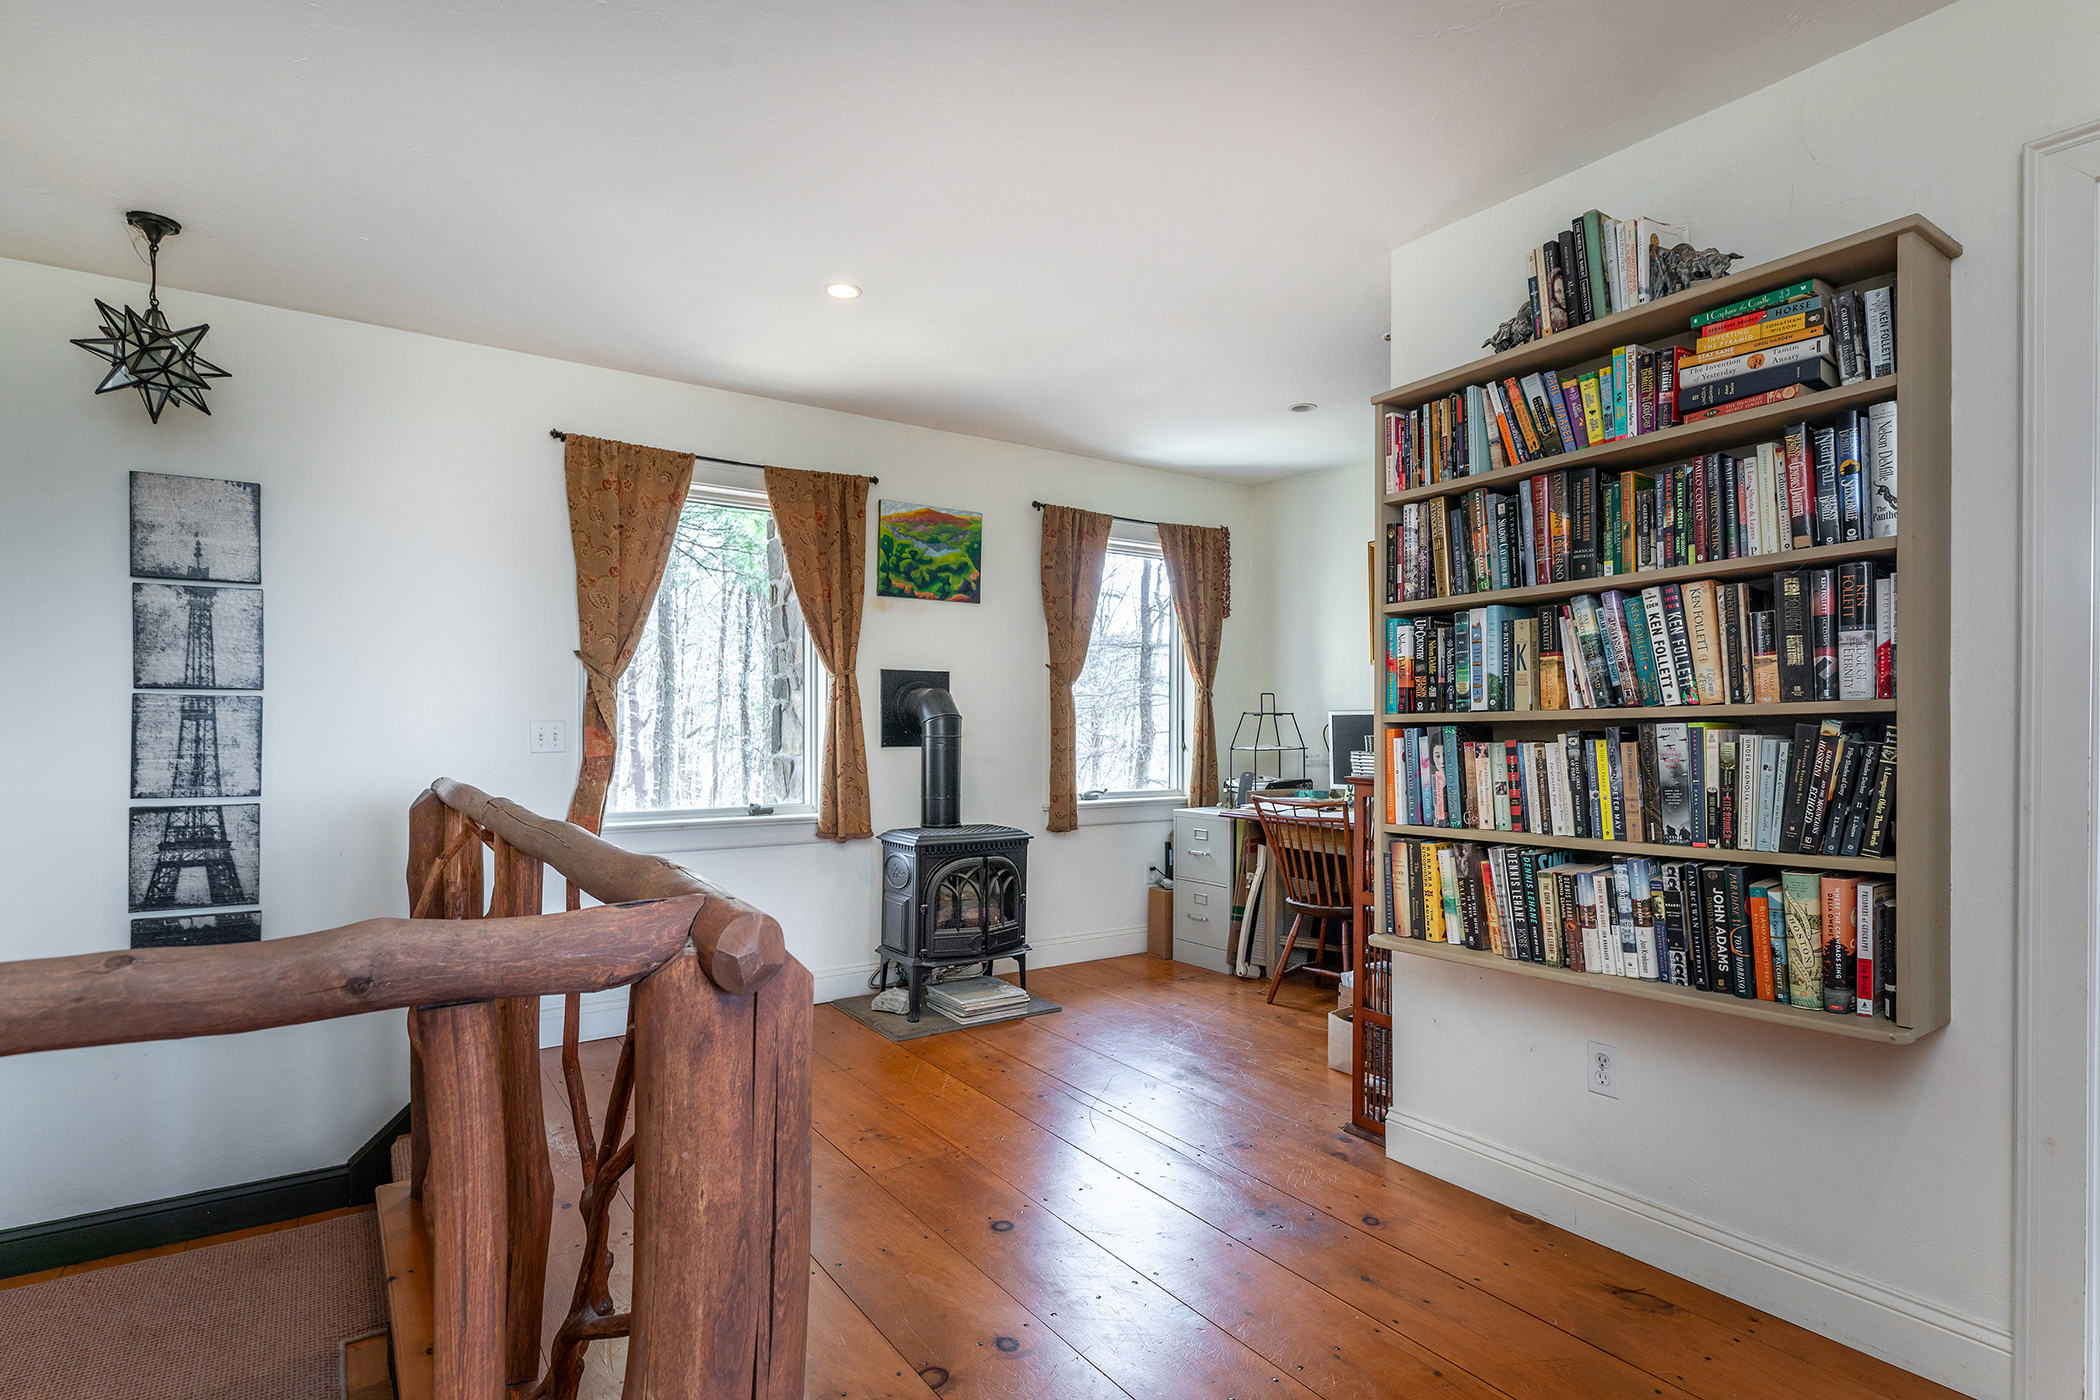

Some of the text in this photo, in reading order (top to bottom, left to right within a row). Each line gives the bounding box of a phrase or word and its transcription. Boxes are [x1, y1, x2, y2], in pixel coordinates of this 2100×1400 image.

[1567, 281, 1575, 297] Aleph
[1711, 306, 1738, 319] Capture
[1739, 303, 1747, 311] the
[1748, 295, 1770, 308] Castle
[1775, 300, 1811, 317] HORSE
[1880, 311, 1889, 327] KEN
[1707, 329, 1749, 343] INVERTING
[1708, 316, 1758, 333] GERALDINE BROOKS
[1766, 317, 1802, 330] JONATHAN
[1770, 323, 1797, 333] WILSON
[1697, 347, 1735, 360] STAY SANE
[1719, 334, 1753, 347] PYRAMID
[1754, 334, 1793, 348] GREG HARDEN
[1772, 344, 1800, 355] Tamim
[1880, 330, 1891, 363] FOLLETT
[1626, 360, 1636, 384] Sheltering
[1702, 368, 1737, 381] Yesterday
[1706, 358, 1741, 371] Invention
[1772, 353, 1800, 364] Ansary
[1547, 373, 1574, 444] CARL HIAASEN
[1726, 400, 1763, 414] SECRET SENSES
[1878, 420, 1893, 481] Nelson DeMille
[1553, 474, 1562, 528] DAN BROWN
[1695, 488, 1703, 521] COELHO
[1778, 472, 1788, 511] Educated
[1430, 502, 1438, 538] ATWOOD
[1582, 477, 1590, 542] WILDERNESS WARRIOR
[1710, 491, 1719, 551] PAULO COELHO
[1873, 513, 1897, 521] Panthe
[1552, 535, 1564, 580] INFERNO
[1784, 578, 1802, 630] KEN FOLLETT
[1842, 574, 1855, 618] FOLLETT
[1856, 584, 1868, 606] KEN
[1575, 608, 1587, 634] CONROY
[1689, 588, 1709, 652] KEN FOLLETT
[1726, 601, 1735, 625] FOLLETT
[1542, 625, 1550, 650] FOLLETT
[1630, 603, 1649, 662] KEN FOLLETT
[1517, 643, 1527, 671] K
[1584, 638, 1595, 660] SOUTH
[1648, 612, 1673, 688] KEN FOLLETT
[1667, 611, 1693, 688] KEN FOLLETT
[1856, 643, 1867, 681] EDGE OF
[1843, 648, 1854, 689] ETERNITY
[1609, 747, 1617, 780] CHESSMEN
[1813, 740, 1827, 778] HOSSEINI
[1823, 750, 1833, 774] KHALED
[1841, 758, 1851, 778] Shades
[1842, 747, 1854, 758] Fifty
[1859, 746, 1874, 795] Fifty Shades Darker
[1878, 771, 1892, 798] Language
[1804, 785, 1818, 824] ECHOED
[1838, 783, 1846, 797] Grey
[1723, 796, 1732, 839] KITE RUNNER
[1872, 815, 1883, 830] Than
[1875, 798, 1886, 815] Older
[1869, 830, 1881, 847] Words
[1507, 853, 1525, 923] DENNIS LEHANE
[1523, 857, 1533, 888] DENNIS
[1616, 865, 1628, 912] Jon Krakauer
[1458, 879, 1469, 933] WALLY LAMB
[1526, 891, 1537, 924] LEHANE
[1688, 871, 1699, 929] IAN McEWAN
[1729, 873, 1740, 917] PARADISE
[1706, 897, 1717, 961] DAVID McCULLOUGH
[1712, 887, 1729, 972] JOHN ADAMS
[1788, 917, 1812, 964] BOSTON
[1641, 949, 1649, 974] Krakauer
[1694, 936, 1702, 974] SATURDAY
[1733, 935, 1746, 994] TONI MORRISON
[1775, 957, 1783, 989] PATCHETT
